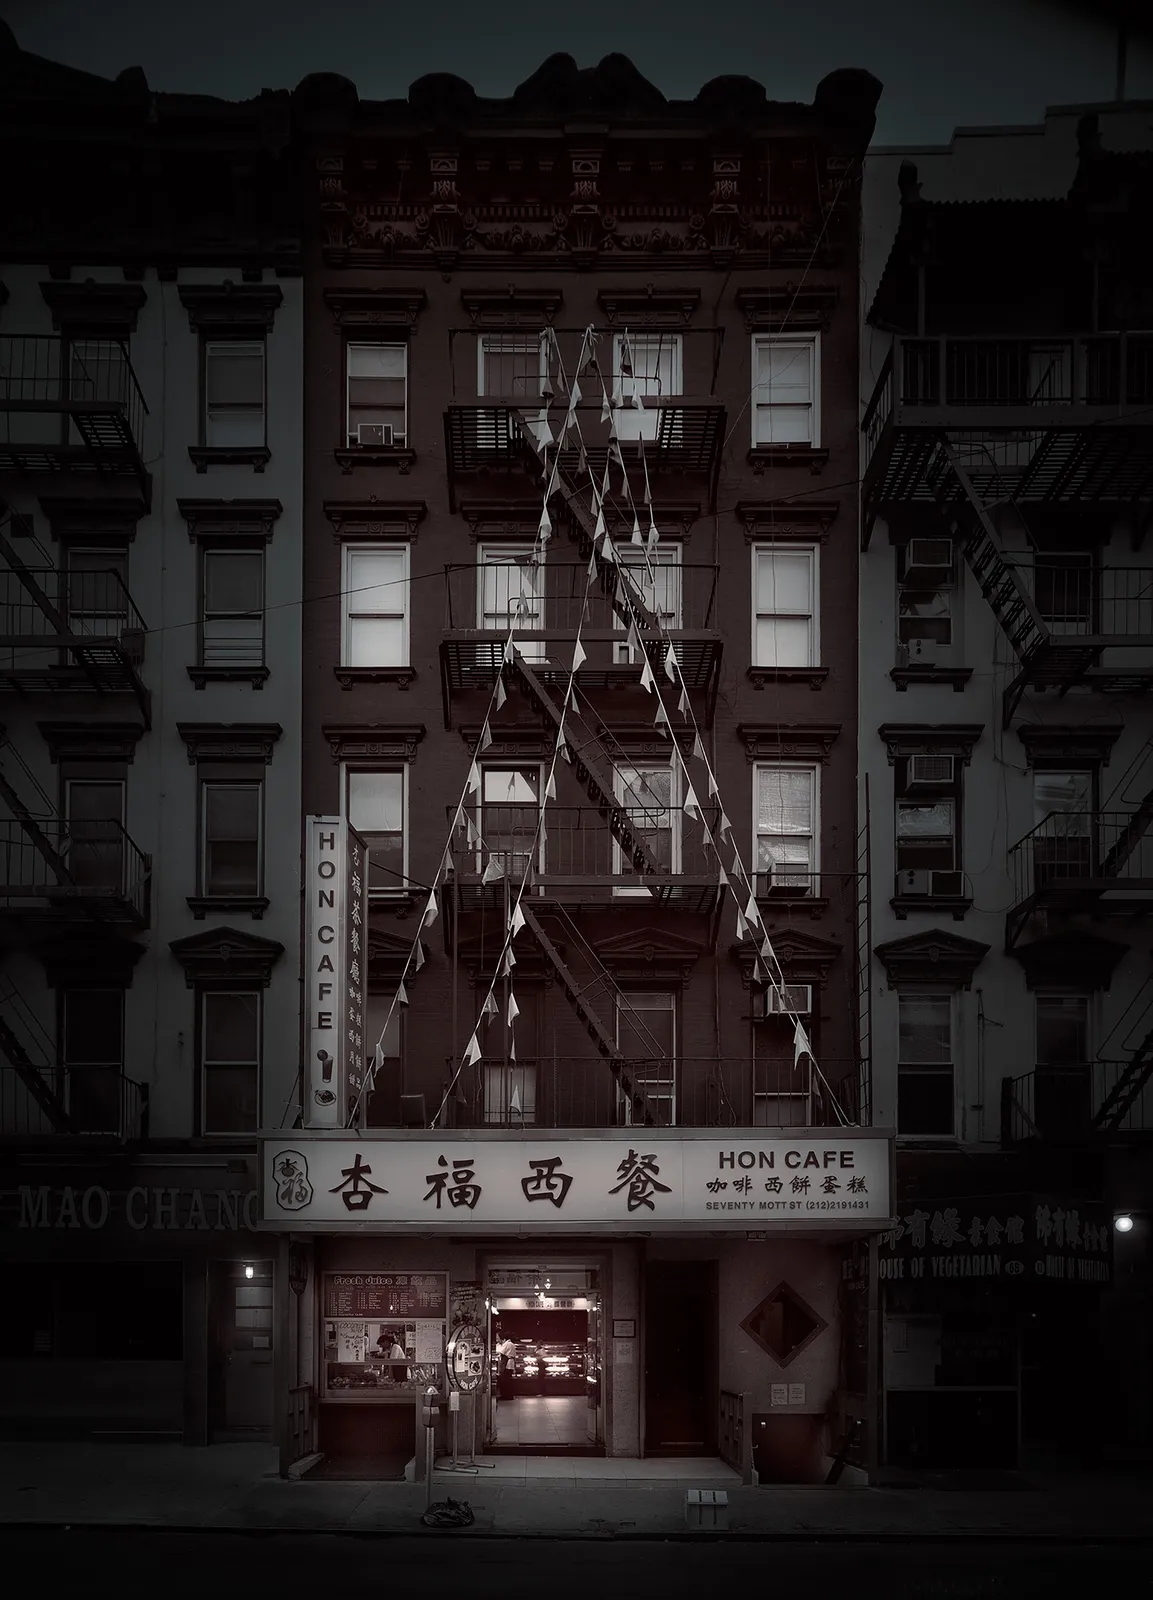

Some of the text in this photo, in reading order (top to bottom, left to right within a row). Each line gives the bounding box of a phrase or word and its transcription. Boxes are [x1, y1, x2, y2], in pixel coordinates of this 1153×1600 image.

[317, 832, 336, 1030] HON CAFE
[719, 1151, 854, 1169] HON CAFE
[327, 1149, 673, 1212] 杏福西餐
[706, 1175, 868, 1196] 咖啡西餅蛋糕
[18, 1185, 109, 1230] MAO
[706, 1200, 870, 1211] SEVENTY MOTT ST (212)2191431
[879, 1257, 904, 1280] OUSE
[911, 1256, 926, 1278] OF
[931, 1254, 1001, 1278] VEGETARIAN
[334, 1275, 363, 1286] Fresh
[365, 1275, 393, 1286] Juice
